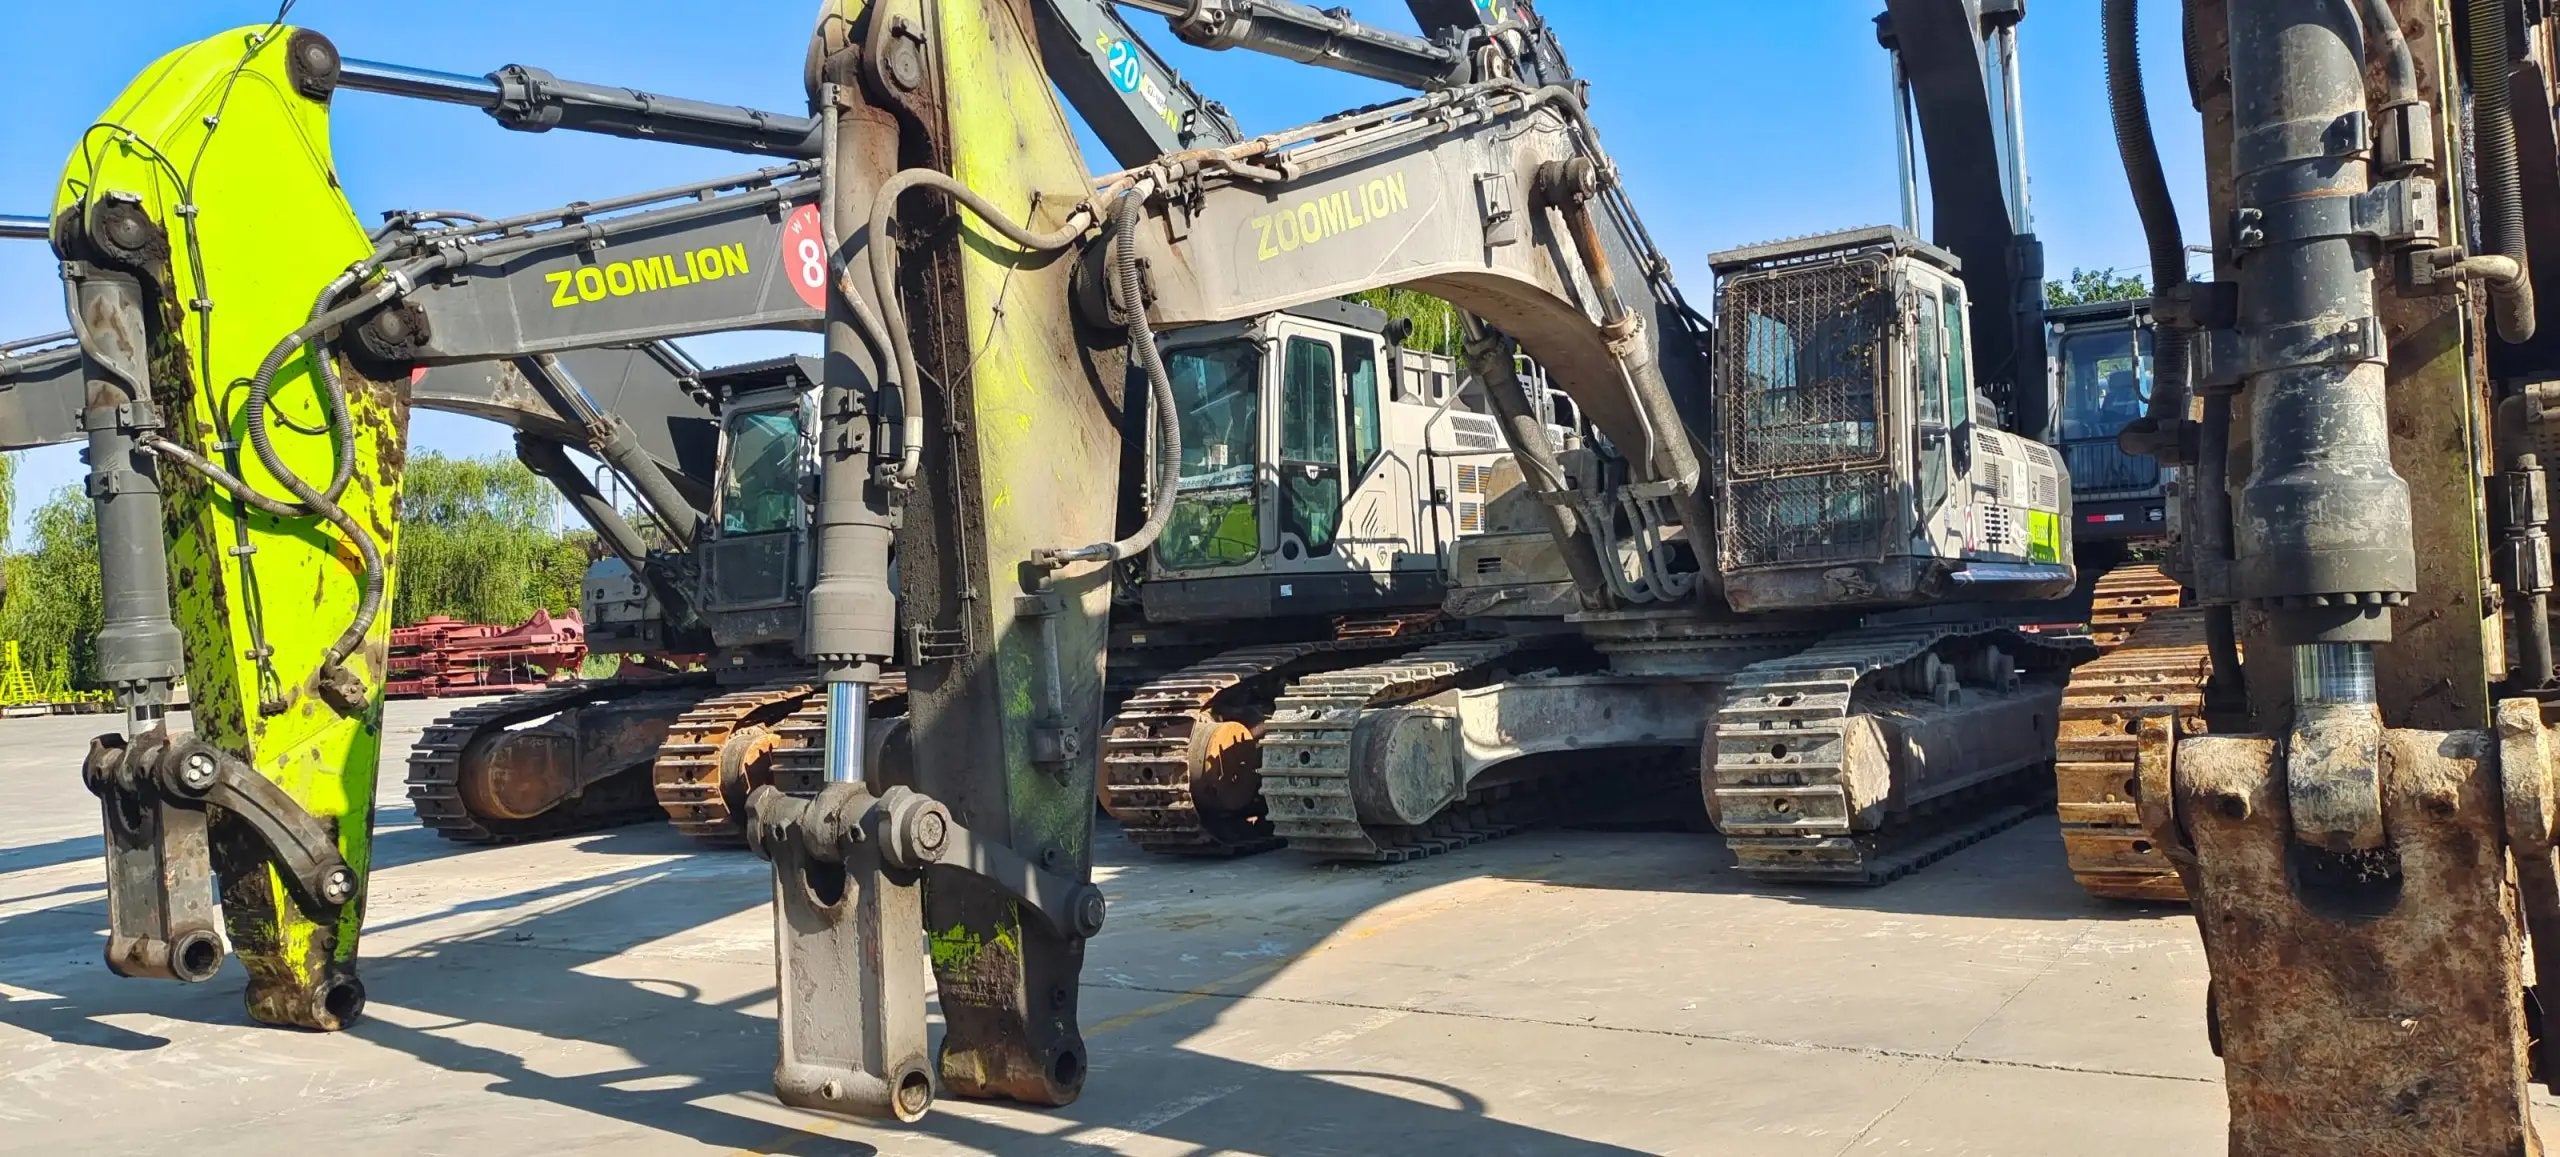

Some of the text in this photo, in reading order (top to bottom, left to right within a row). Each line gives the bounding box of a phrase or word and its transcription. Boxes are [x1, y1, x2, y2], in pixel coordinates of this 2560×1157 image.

[1109, 41, 1138, 89] 20
[791, 211, 821, 234] WY
[1251, 171, 1409, 261] ZOOMLION
[545, 242, 750, 308] ZOOMLION
[798, 238, 827, 288] 8
